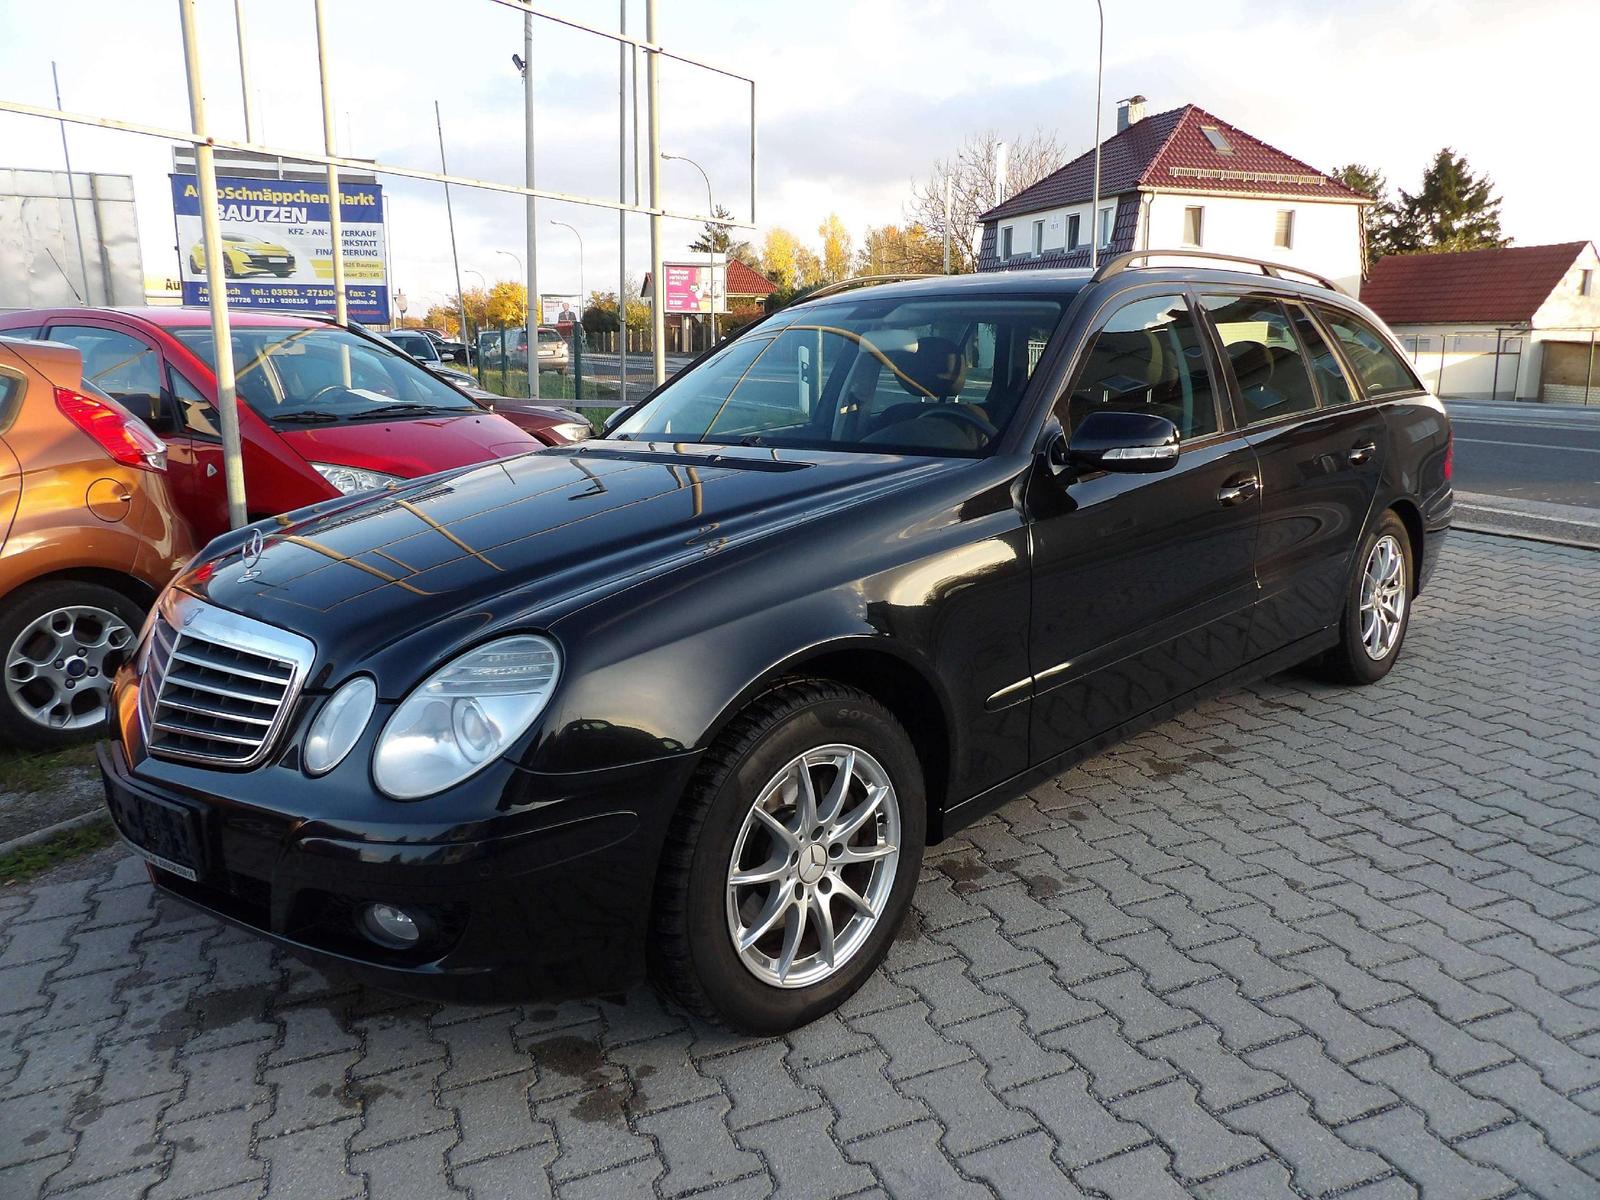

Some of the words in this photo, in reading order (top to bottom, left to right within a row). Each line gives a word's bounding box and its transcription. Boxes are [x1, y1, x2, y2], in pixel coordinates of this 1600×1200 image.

[184, 184, 375, 206] AoSchnäppchenarkt
[217, 203, 307, 224] BAUTZEN
[288, 228, 304, 236] KFZ
[341, 239, 377, 247] ERKSTATT
[315, 248, 378, 257] FINAZIERUNG
[271, 288, 300, 297] 03591
